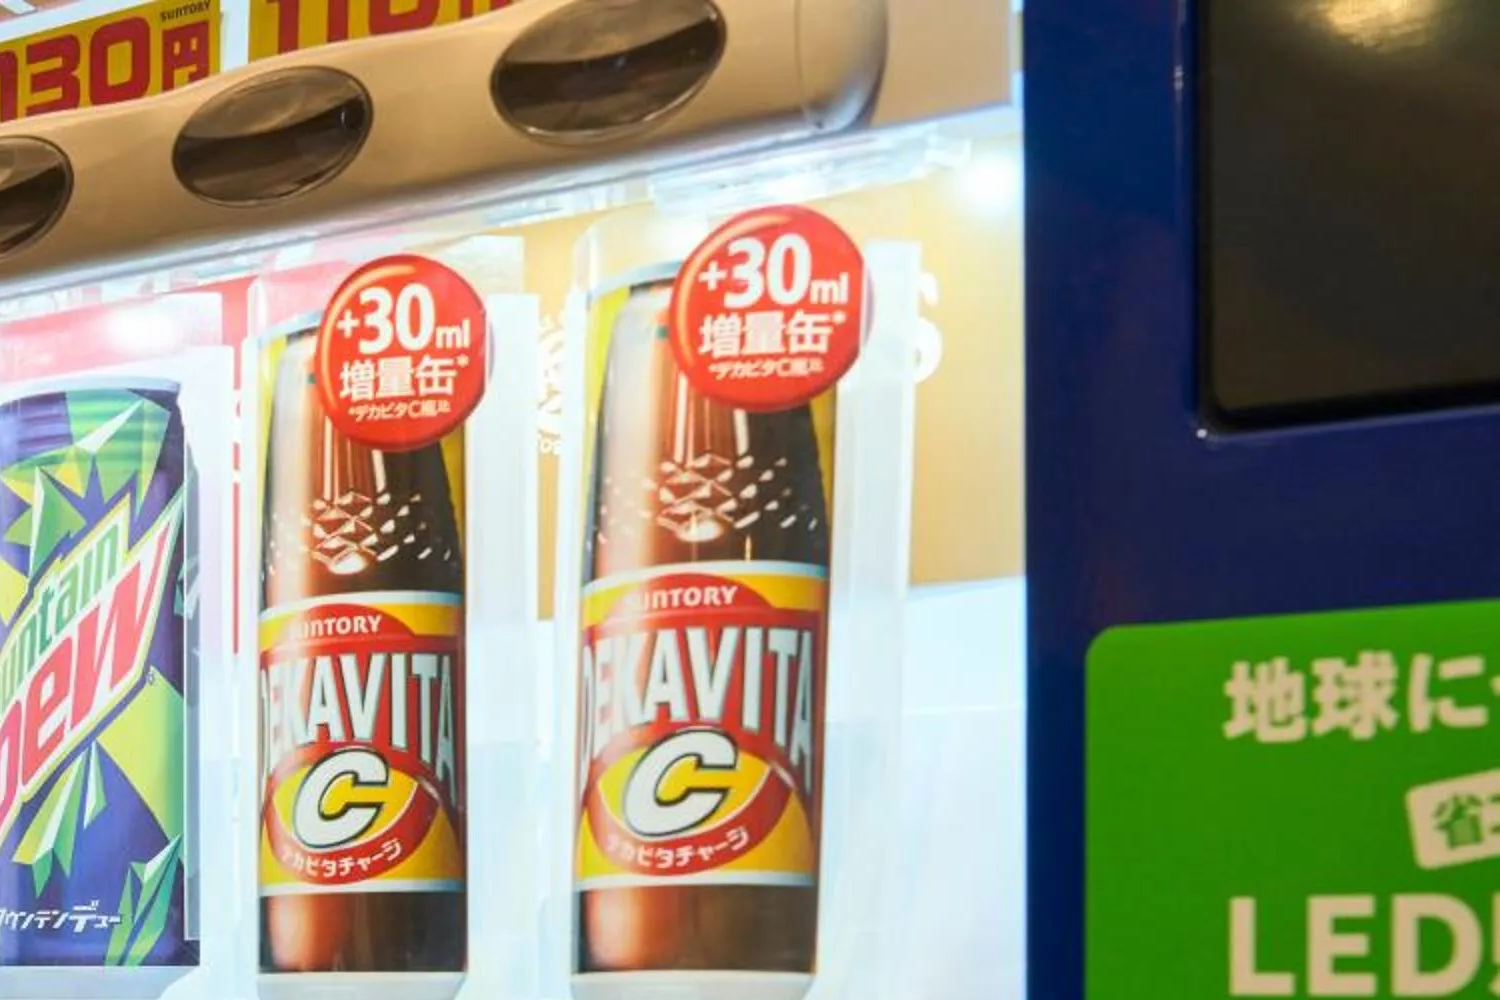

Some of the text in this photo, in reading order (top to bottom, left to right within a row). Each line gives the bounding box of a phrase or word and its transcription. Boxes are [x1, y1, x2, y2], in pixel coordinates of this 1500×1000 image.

[1222, 649, 1500, 743] 地球に
[293, 748, 390, 850] C
[622, 728, 739, 838] C
[1228, 892, 1500, 998] LED
